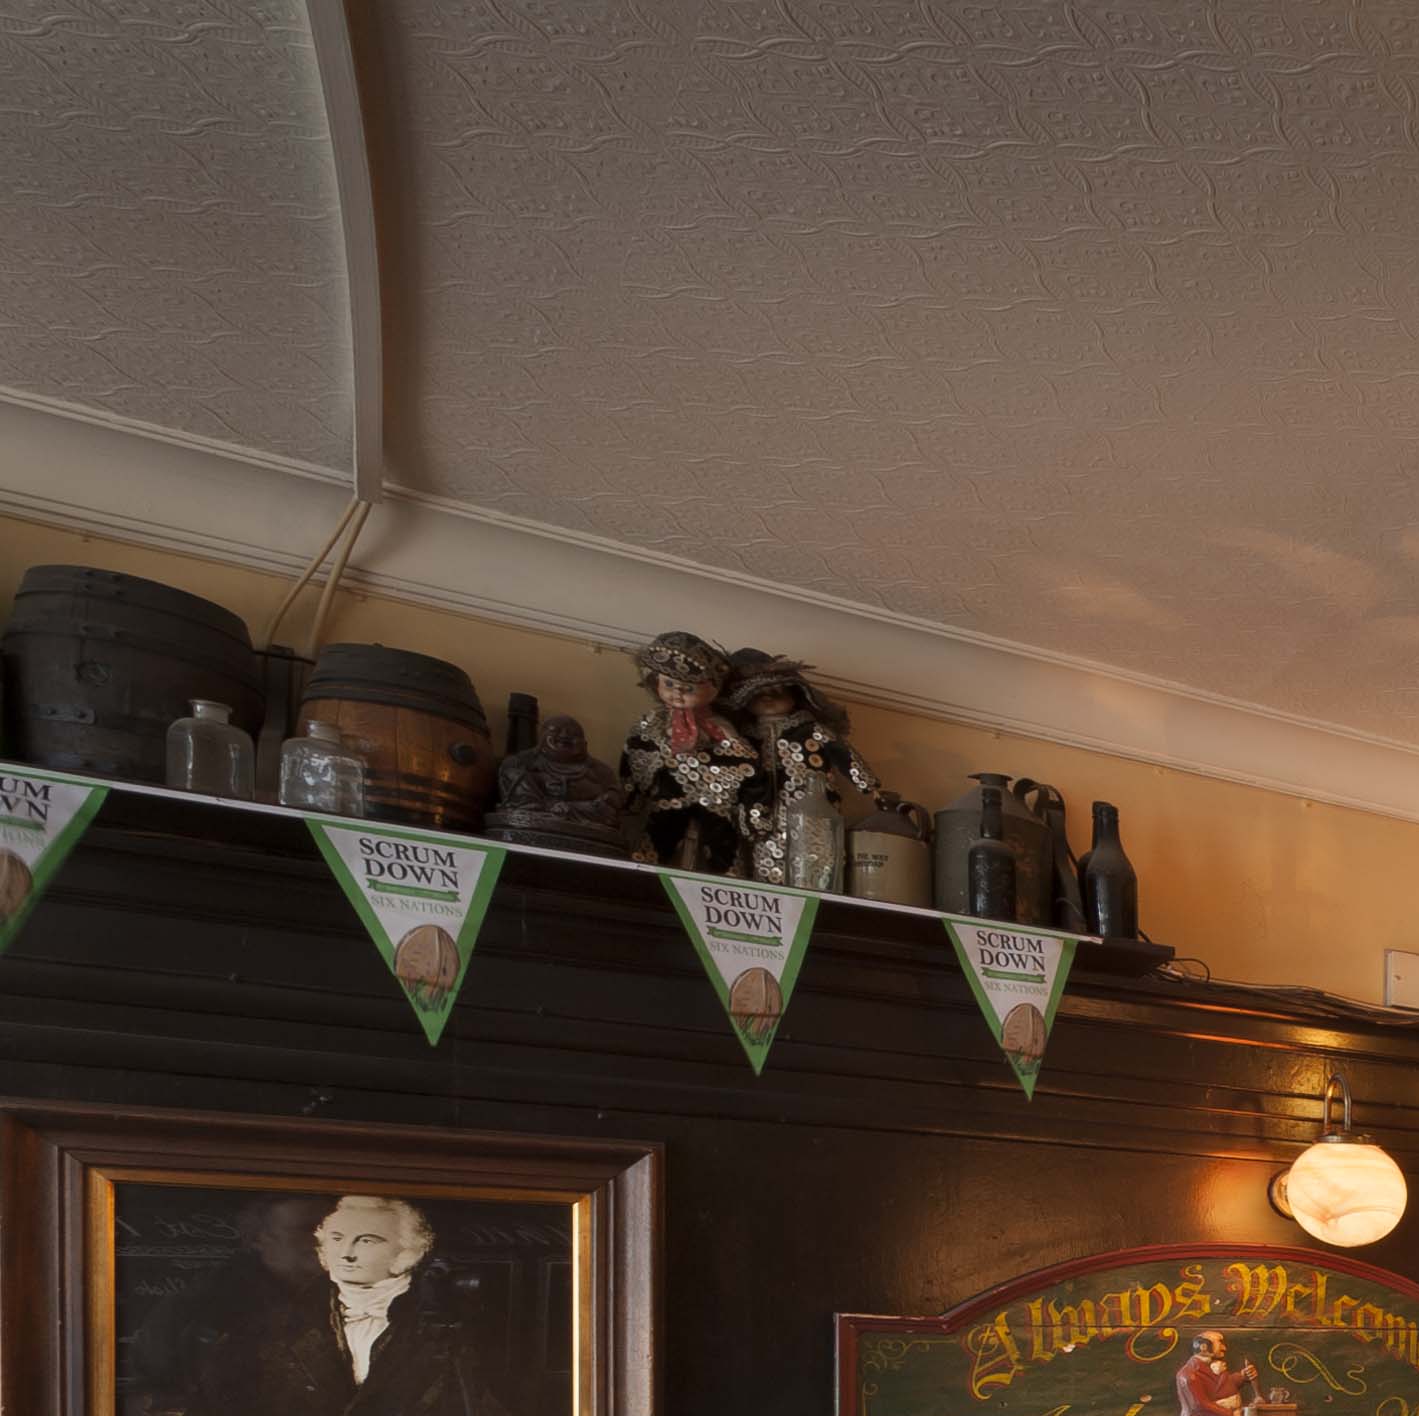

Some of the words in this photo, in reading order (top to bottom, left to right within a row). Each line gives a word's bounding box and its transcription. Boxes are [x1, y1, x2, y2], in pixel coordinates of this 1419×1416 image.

[359, 837, 457, 869] SCRUM
[363, 859, 459, 889] DOWN
[371, 894, 397, 909] SIX
[400, 898, 463, 918] NATIONS
[701, 886, 782, 914] SCRUM
[704, 905, 783, 934] DOWN
[732, 943, 785, 961] NATIONS
[976, 930, 1045, 954] SCRUM
[979, 948, 1046, 972] DOWN
[967, 1264, 1212, 1400] Always
